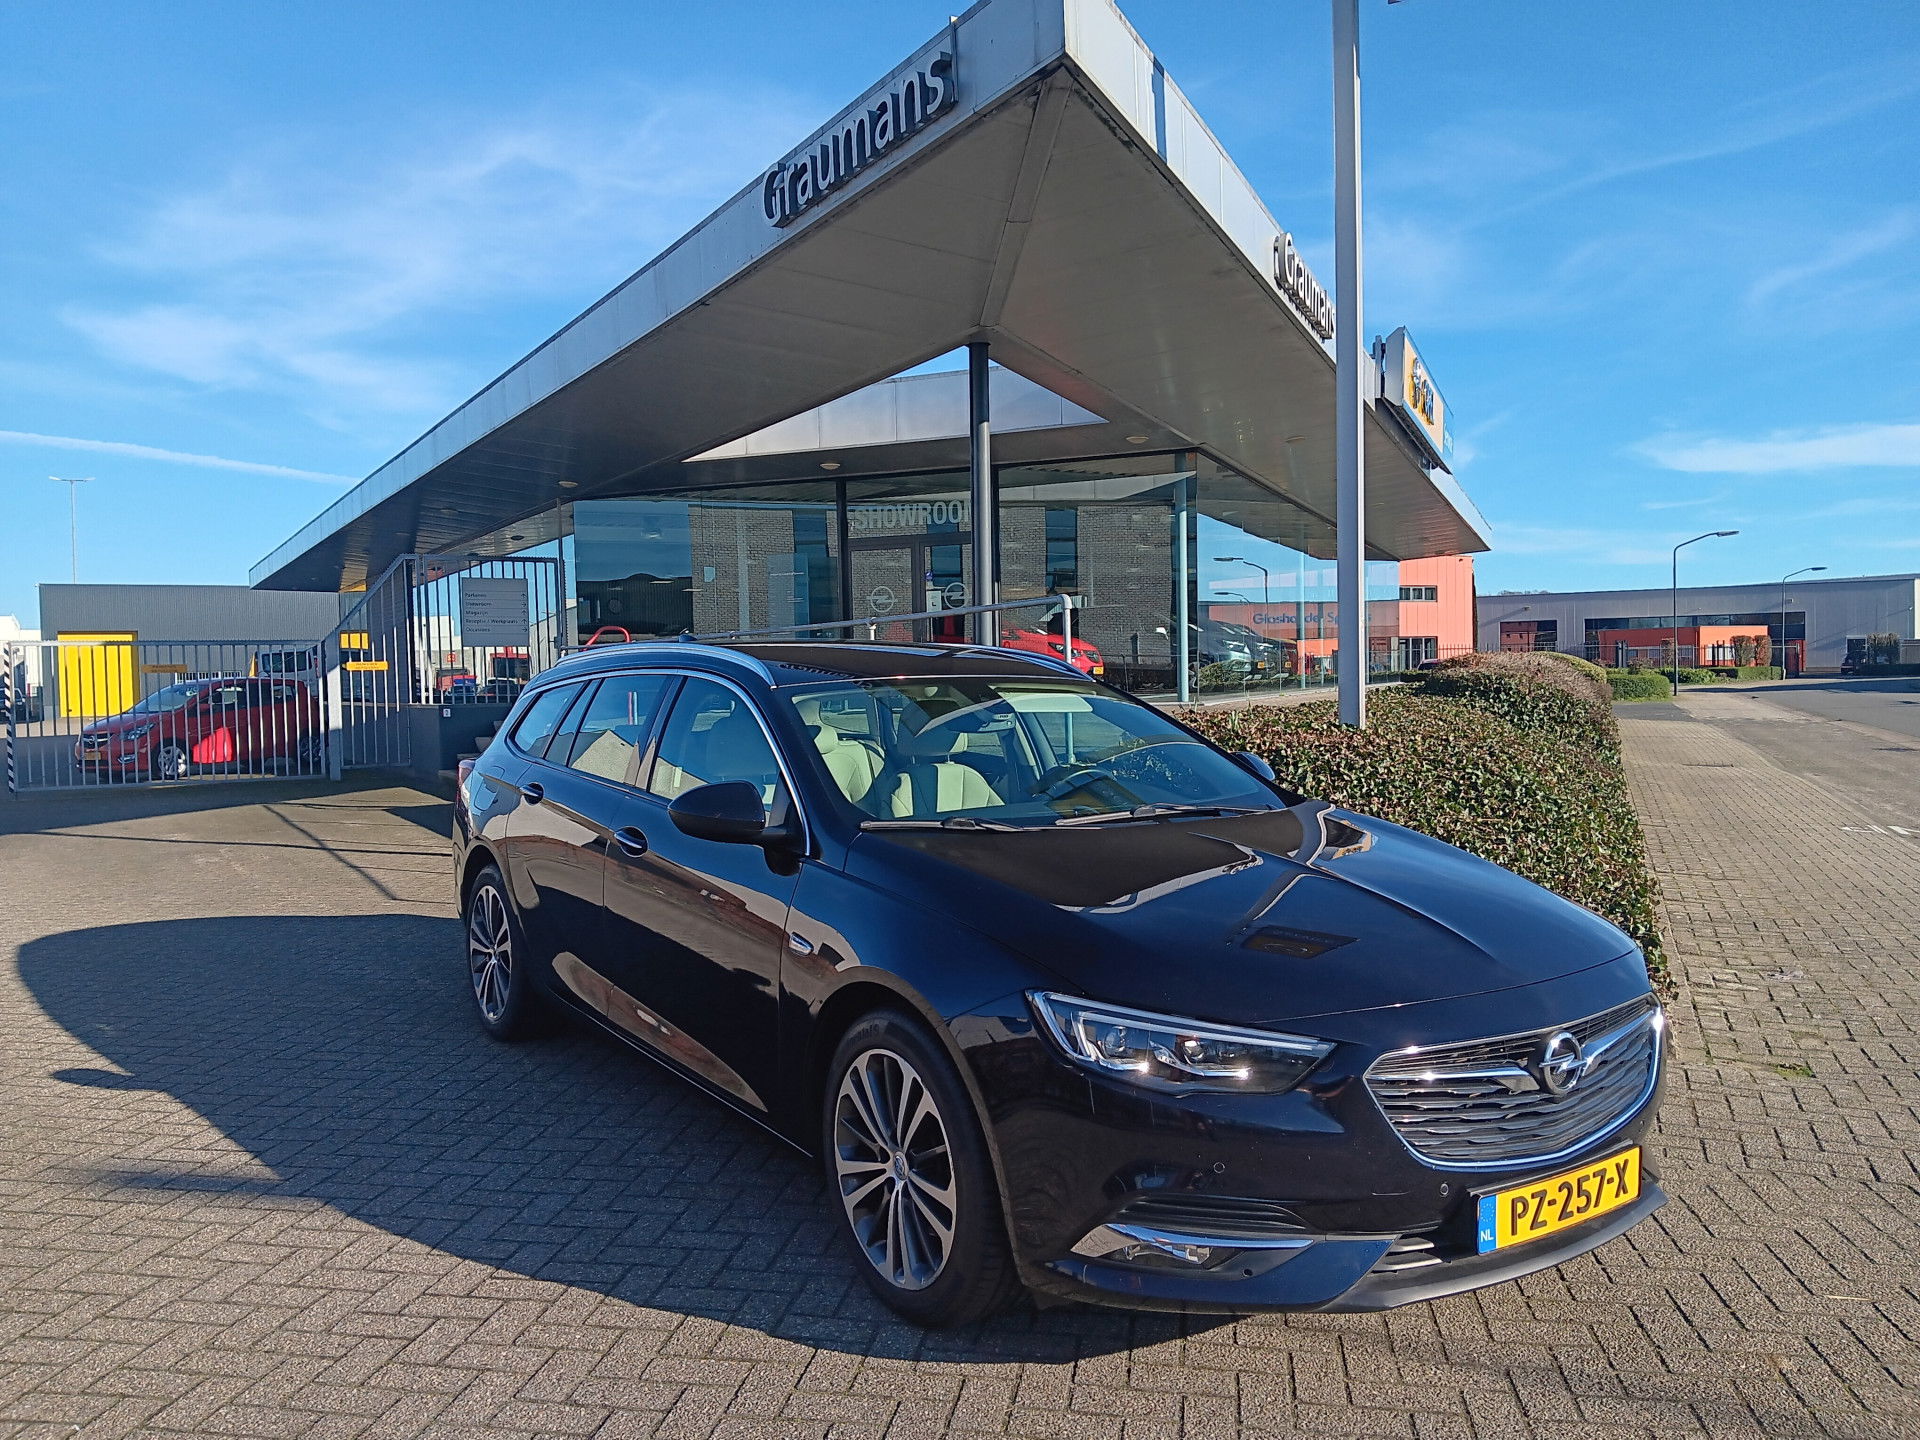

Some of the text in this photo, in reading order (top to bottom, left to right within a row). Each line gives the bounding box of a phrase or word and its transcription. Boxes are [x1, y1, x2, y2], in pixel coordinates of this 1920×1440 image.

[763, 51, 956, 228] Graumans
[1480, 1227, 1494, 1242] NL
[1511, 1158, 1629, 1236] PZ-257-X
